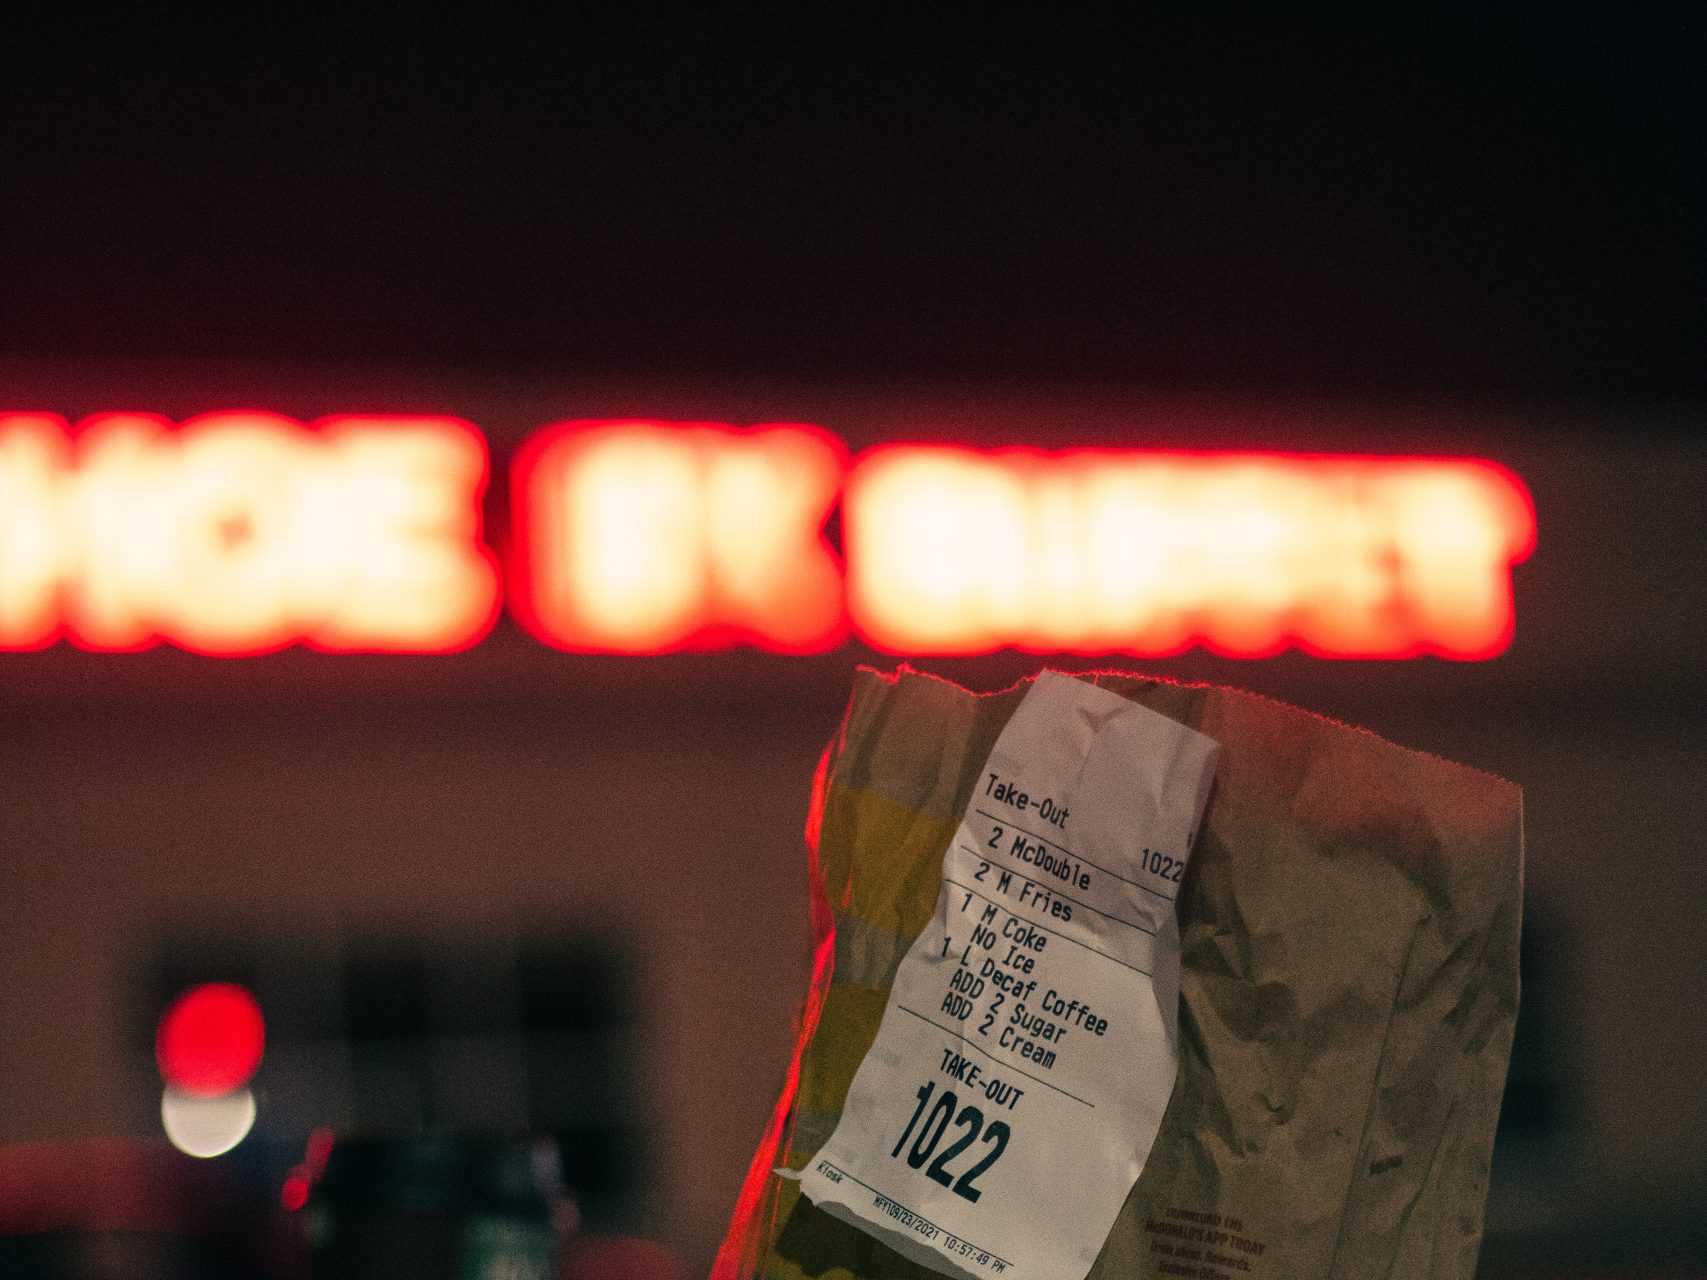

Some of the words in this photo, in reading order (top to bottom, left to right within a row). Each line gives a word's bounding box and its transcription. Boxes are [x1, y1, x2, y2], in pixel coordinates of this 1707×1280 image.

[985, 773, 1070, 829] Take-Out
[988, 826, 1004, 850] 2
[1009, 835, 1091, 891] McDouble
[1141, 848, 1184, 883] 1022
[961, 892, 974, 912] 1
[980, 904, 998, 925] M
[1002, 917, 1047, 952] Coke
[974, 862, 991, 882] 2
[996, 872, 1012, 894] M
[1018, 881, 1073, 922] Fries
[941, 937, 952, 958] 1
[960, 945, 972, 967] L
[979, 957, 1038, 1001] Decaf
[1041, 989, 1108, 1037] Coffee
[1002, 945, 1035, 974] Ice
[940, 992, 974, 1022] ADD
[978, 1014, 995, 1036] 2
[999, 1026, 1057, 1070] Cream
[949, 968, 985, 1000] ADD
[989, 993, 1006, 1015] 2
[1010, 1003, 1068, 1045] Sugar
[940, 1048, 1024, 1111] TAKE-OUT
[890, 1081, 1012, 1204] 1022
[942, 1236, 989, 1266] 10:57:49
[990, 1259, 1006, 1274] PM
